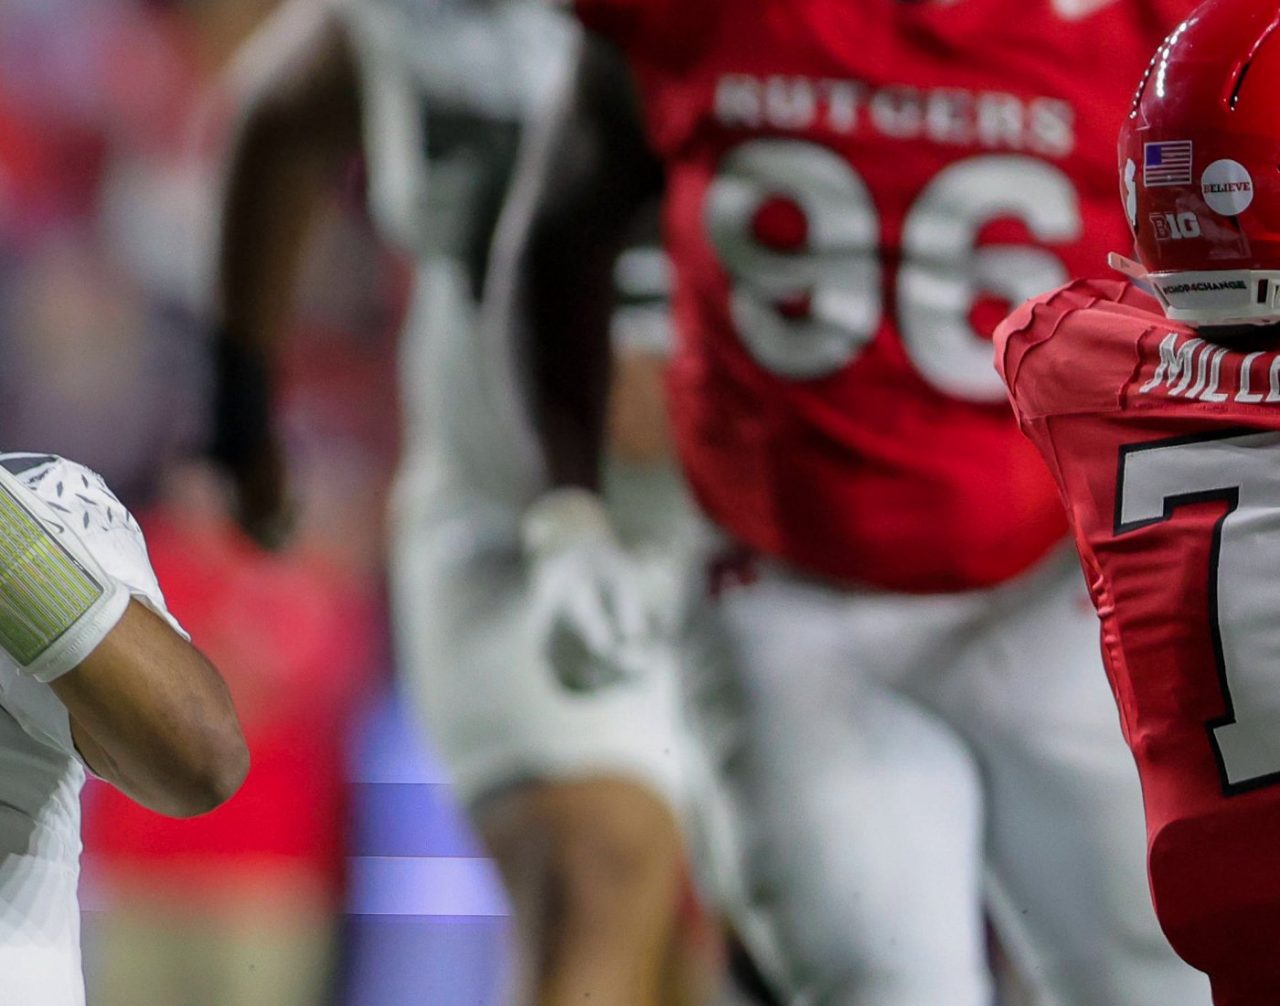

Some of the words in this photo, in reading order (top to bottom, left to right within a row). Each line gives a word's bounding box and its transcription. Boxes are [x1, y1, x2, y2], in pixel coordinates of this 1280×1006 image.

[714, 73, 1074, 155] RUTGERS
[1203, 181, 1251, 194] BELIEVE
[704, 138, 1084, 402] 96
[1113, 426, 1280, 797] 7
